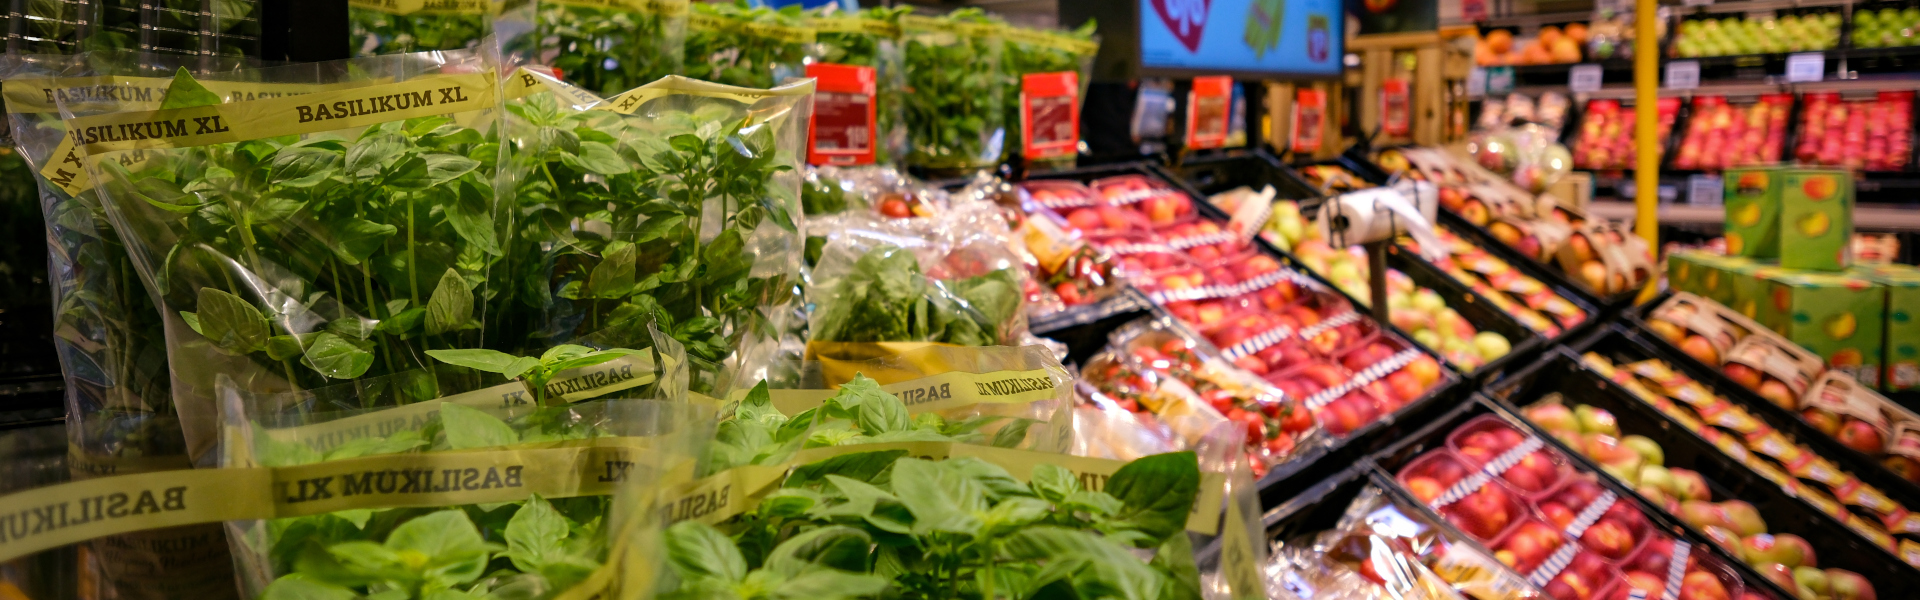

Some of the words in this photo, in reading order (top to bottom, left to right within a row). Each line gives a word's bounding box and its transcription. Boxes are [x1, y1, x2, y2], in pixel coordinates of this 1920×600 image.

[296, 90, 433, 123] BASILIKUM
[438, 86, 468, 104] XL
[618, 93, 644, 112] XL
[193, 115, 229, 134] XL
